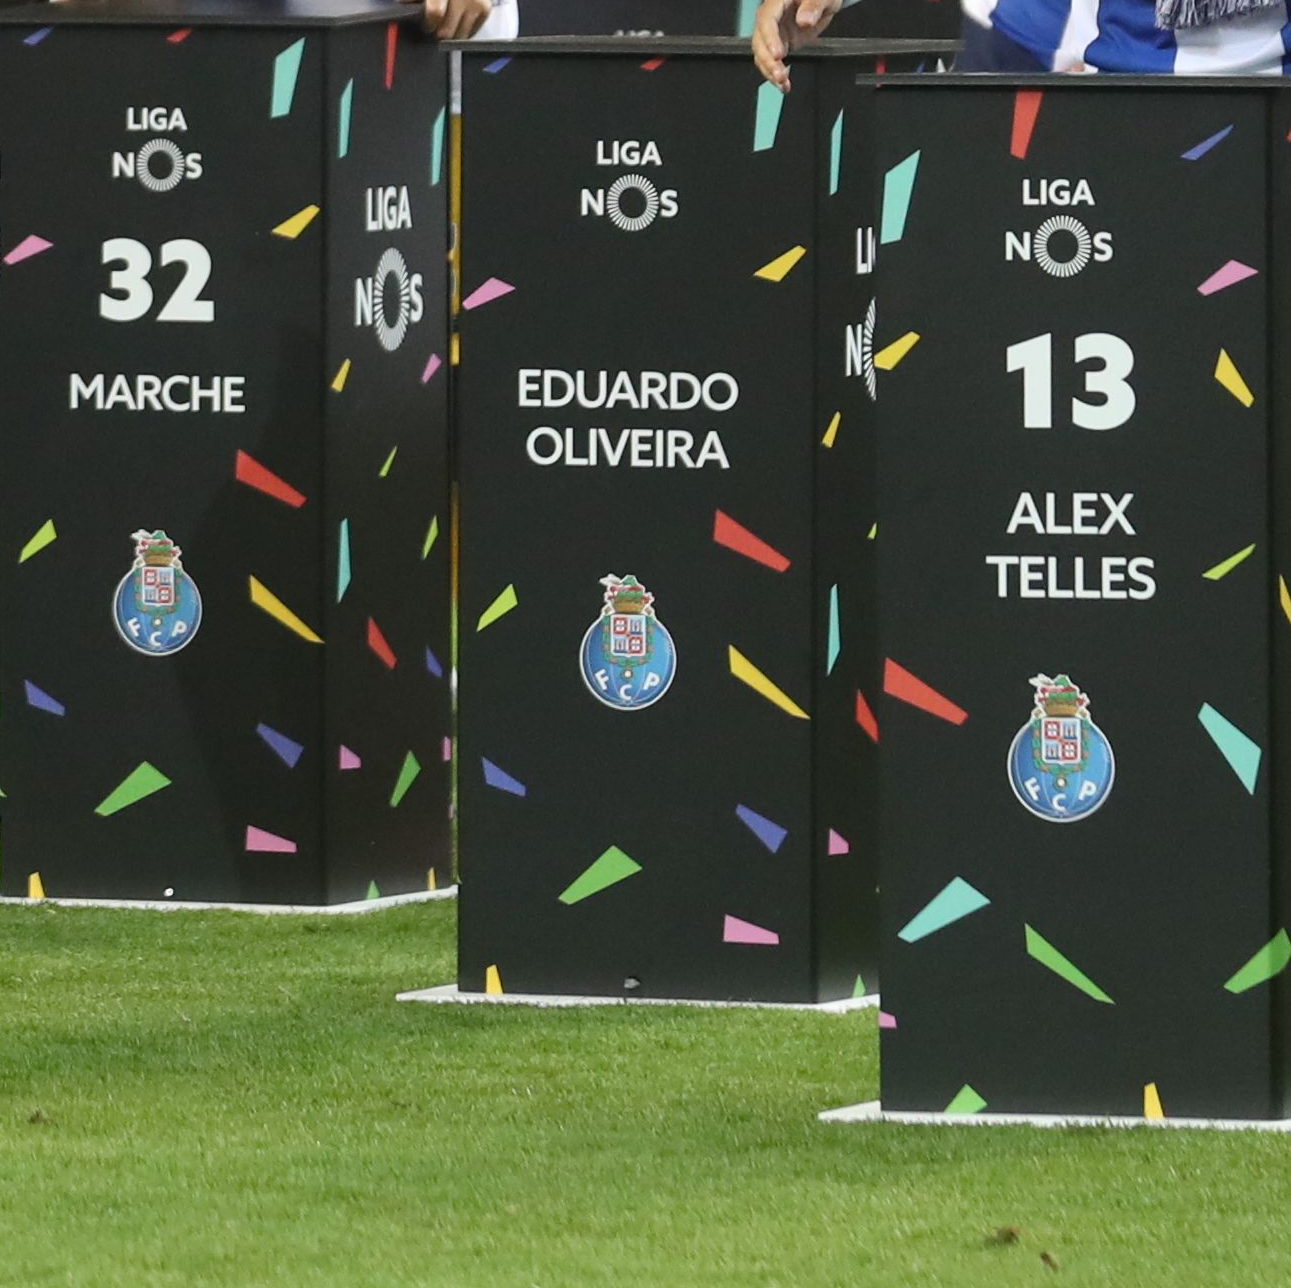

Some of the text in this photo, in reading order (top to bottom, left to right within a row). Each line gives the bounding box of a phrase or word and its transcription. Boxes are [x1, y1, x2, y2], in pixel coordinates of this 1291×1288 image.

[127, 107, 187, 131] LIGA
[113, 139, 202, 191] NOS
[597, 141, 662, 166] LIGA
[366, 186, 412, 232] LIGA
[581, 174, 678, 231] NOS
[1023, 179, 1095, 206] LIGA
[857, 227, 875, 274] LI
[1006, 215, 1113, 277] NOS
[100, 238, 214, 322] 32
[355, 248, 424, 351] NOS
[70, 374, 245, 412] MARCHE
[519, 369, 738, 411] EDUARDO
[1007, 333, 1135, 430] 13
[526, 427, 729, 468] OLIVEIRA
[1007, 492, 1136, 535] ALEX
[986, 556, 1156, 600] TELLES
